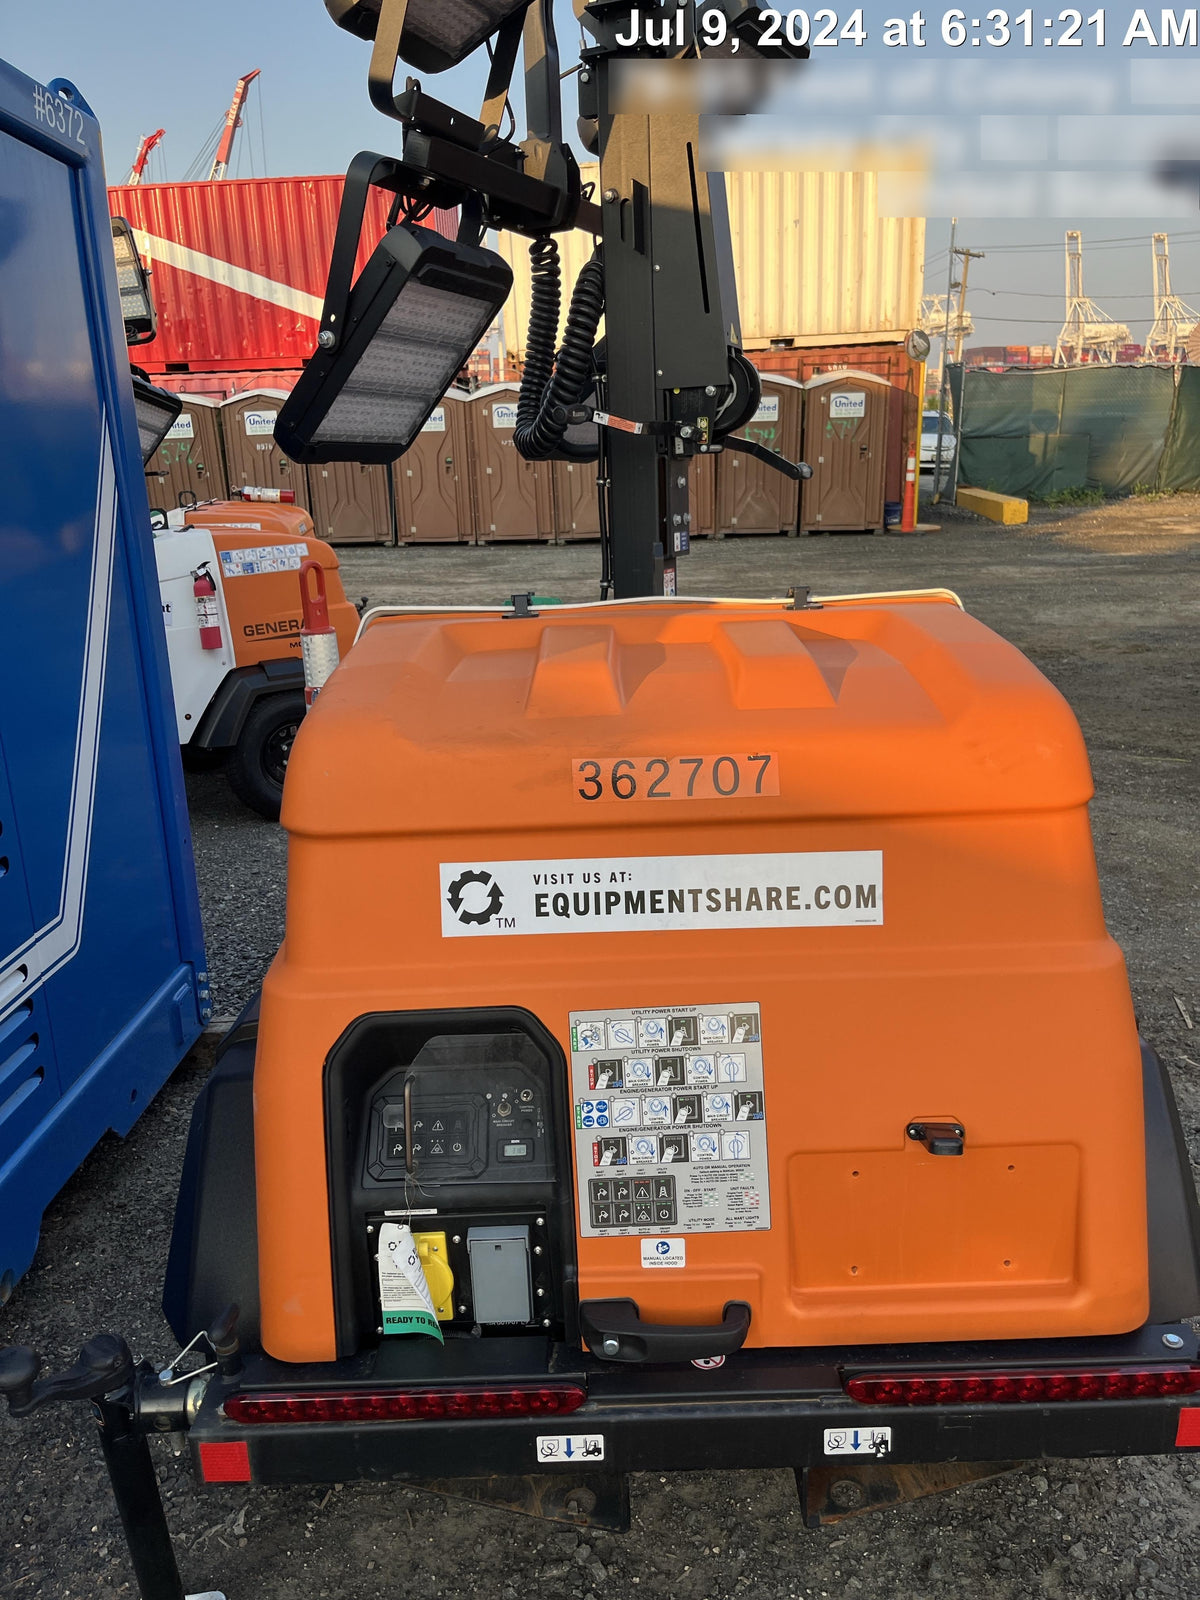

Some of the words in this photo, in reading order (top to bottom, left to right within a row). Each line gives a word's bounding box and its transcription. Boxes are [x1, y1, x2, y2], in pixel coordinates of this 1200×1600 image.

[32, 84, 86, 146] #6372
[758, 404, 777, 412] nited
[835, 400, 863, 408] United
[496, 410, 518, 418] Unite
[243, 619, 305, 636] GENER
[577, 754, 772, 801] 362707
[533, 873, 574, 885] VISIT
[582, 872, 601, 884] US
[610, 872, 632, 883] AT:
[535, 883, 877, 919] EQUIPMENTSHARE.COM
[495, 917, 516, 928] TM
[386, 1316, 414, 1324] READY
[415, 1316, 426, 1324] TO
